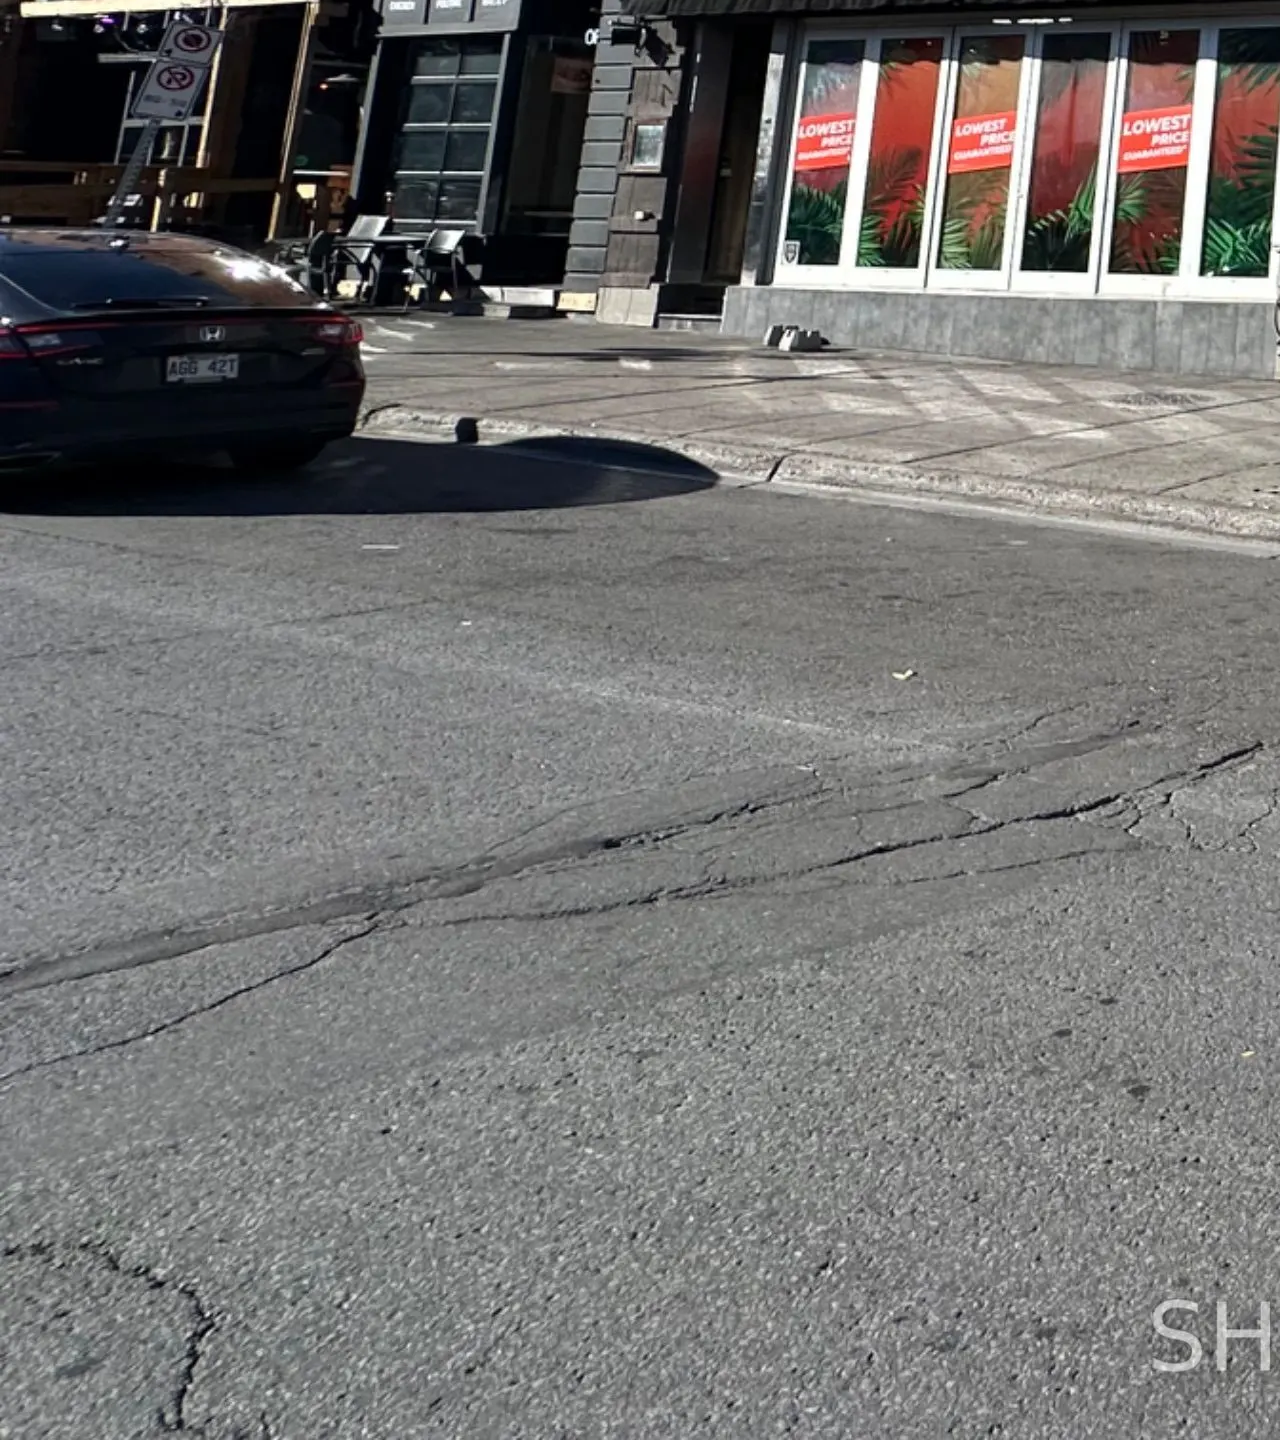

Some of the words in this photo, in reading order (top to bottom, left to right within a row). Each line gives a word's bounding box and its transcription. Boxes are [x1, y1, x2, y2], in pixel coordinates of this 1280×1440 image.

[798, 119, 856, 138] LOWEST
[955, 117, 1008, 137] LOWEST
[1123, 114, 1191, 136] LOWEST
[1151, 131, 1190, 147] PRICE
